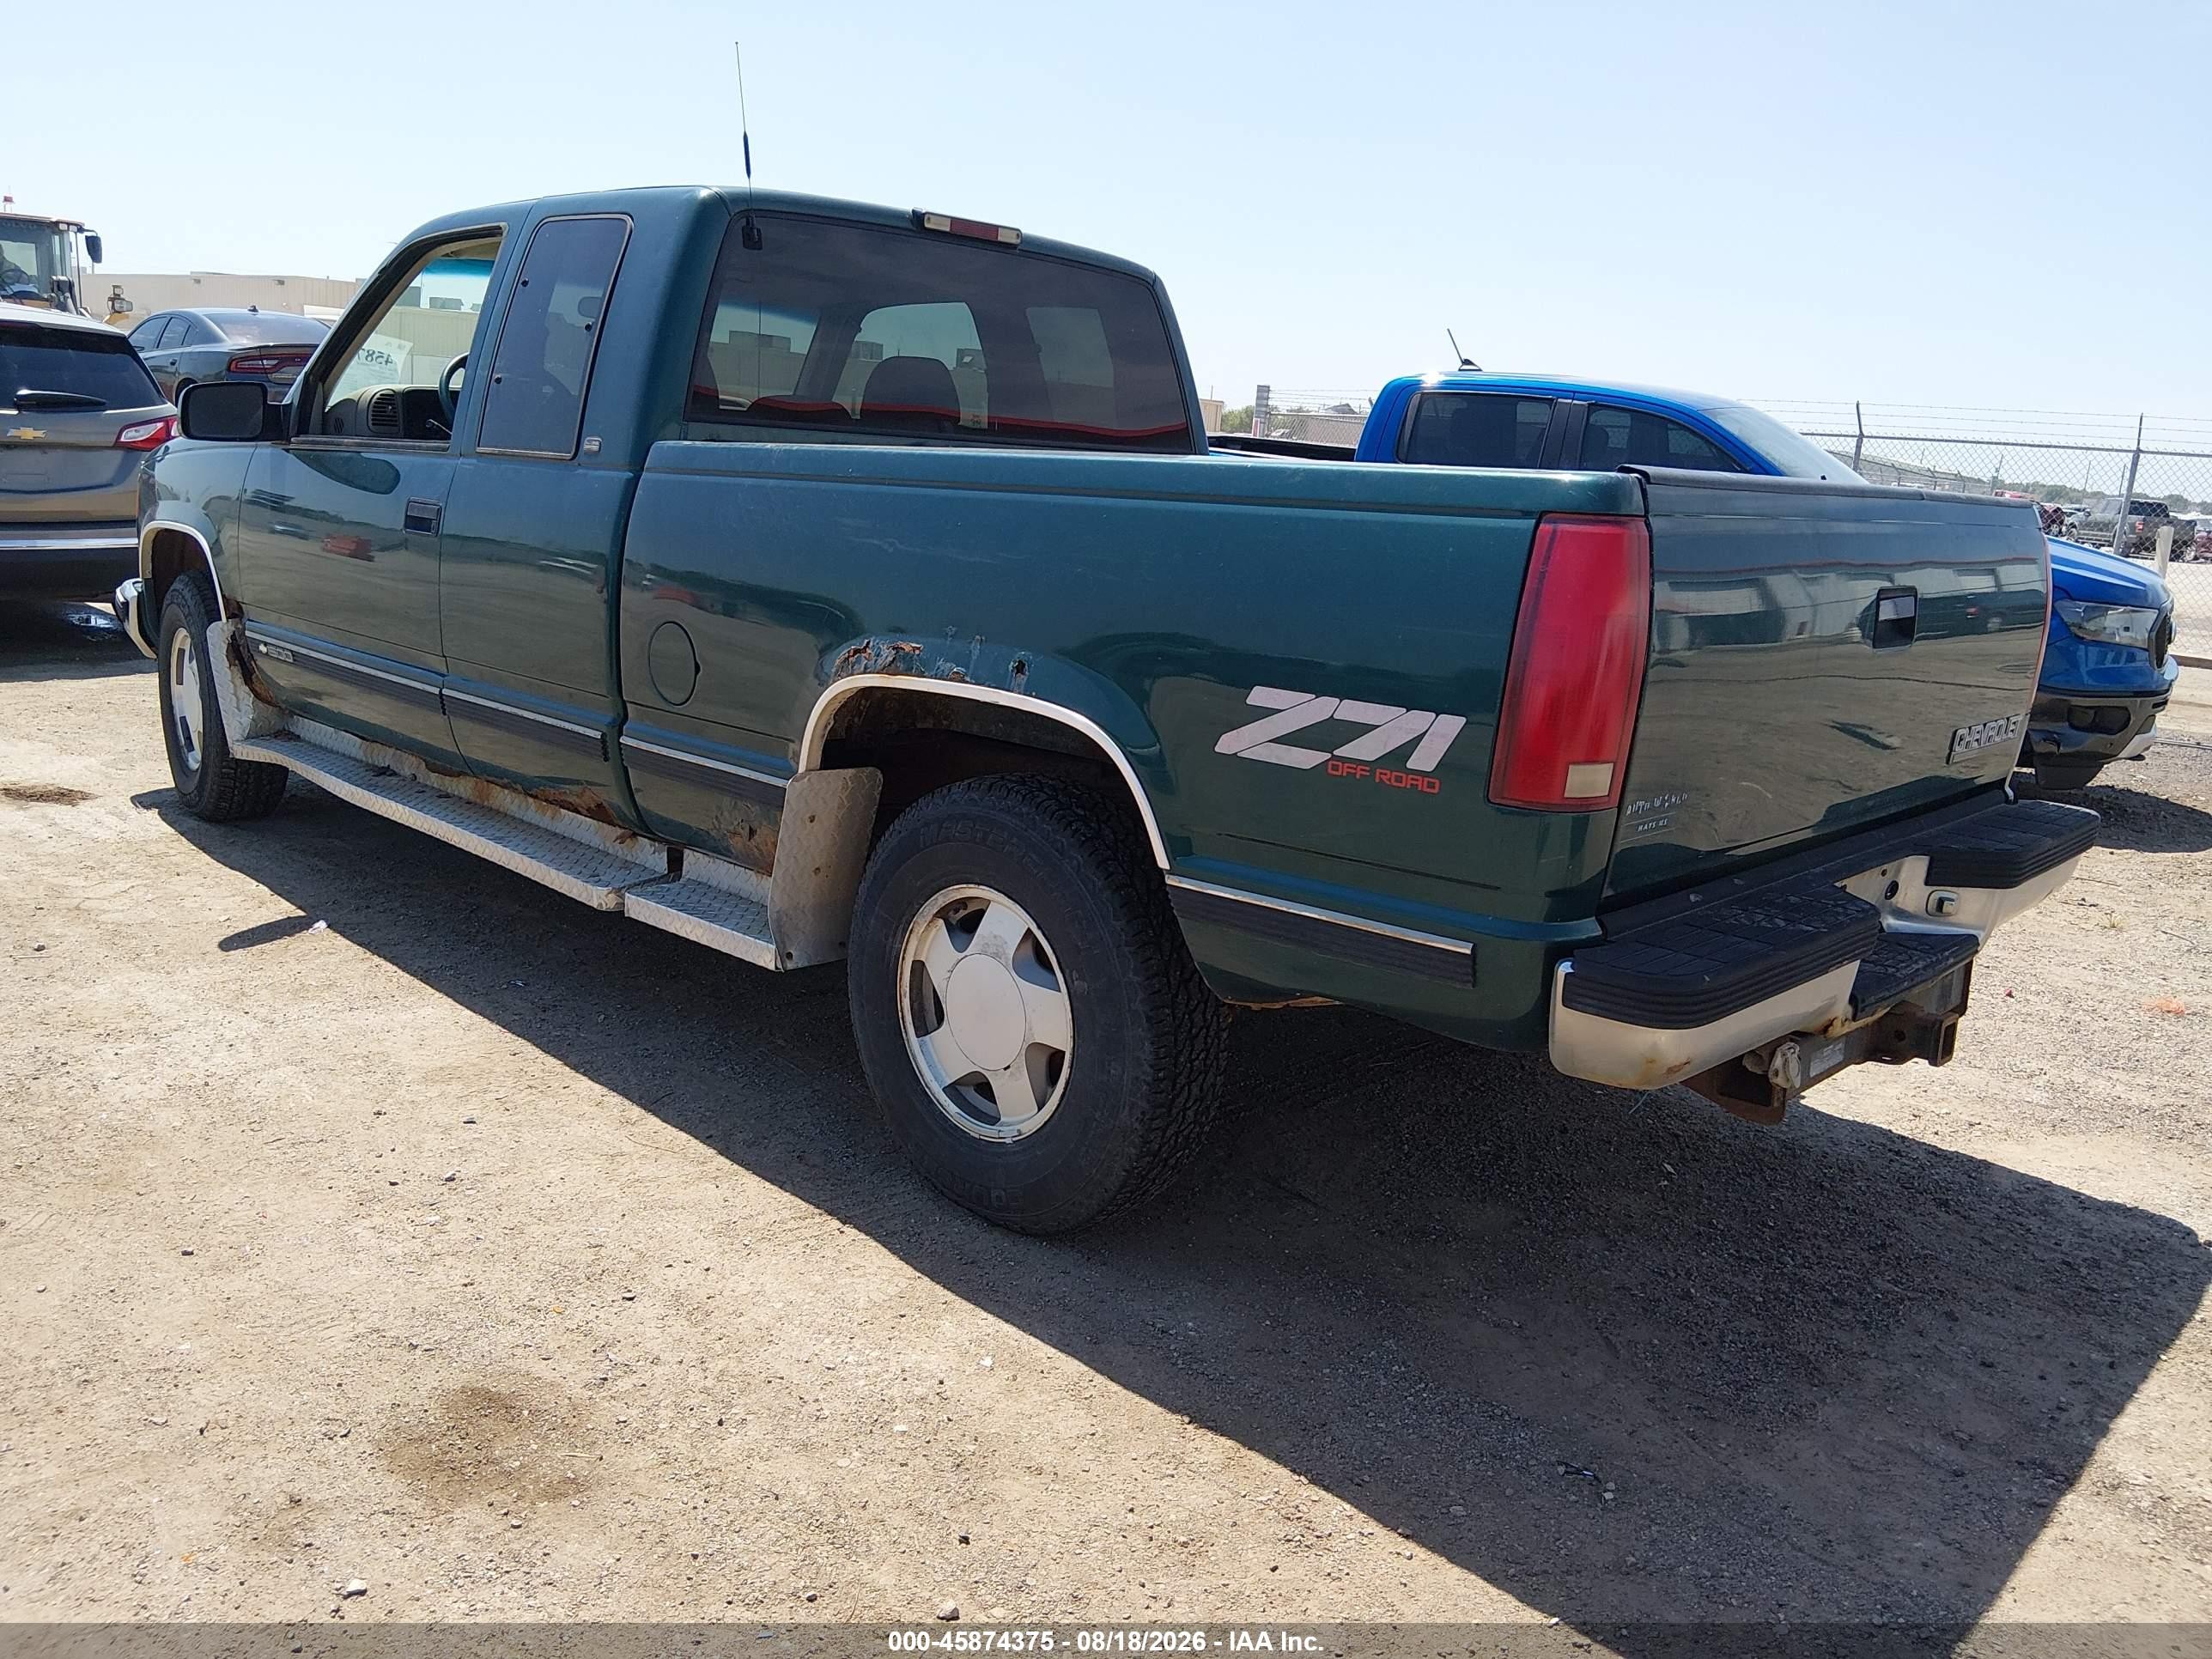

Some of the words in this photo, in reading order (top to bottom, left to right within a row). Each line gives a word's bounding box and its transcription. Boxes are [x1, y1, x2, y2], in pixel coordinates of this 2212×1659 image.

[1213, 685, 1467, 772] Z71
[1954, 714, 2022, 752] CHEVROLET
[1328, 760, 1370, 780] OFF
[1376, 769, 1441, 794] ROAD
